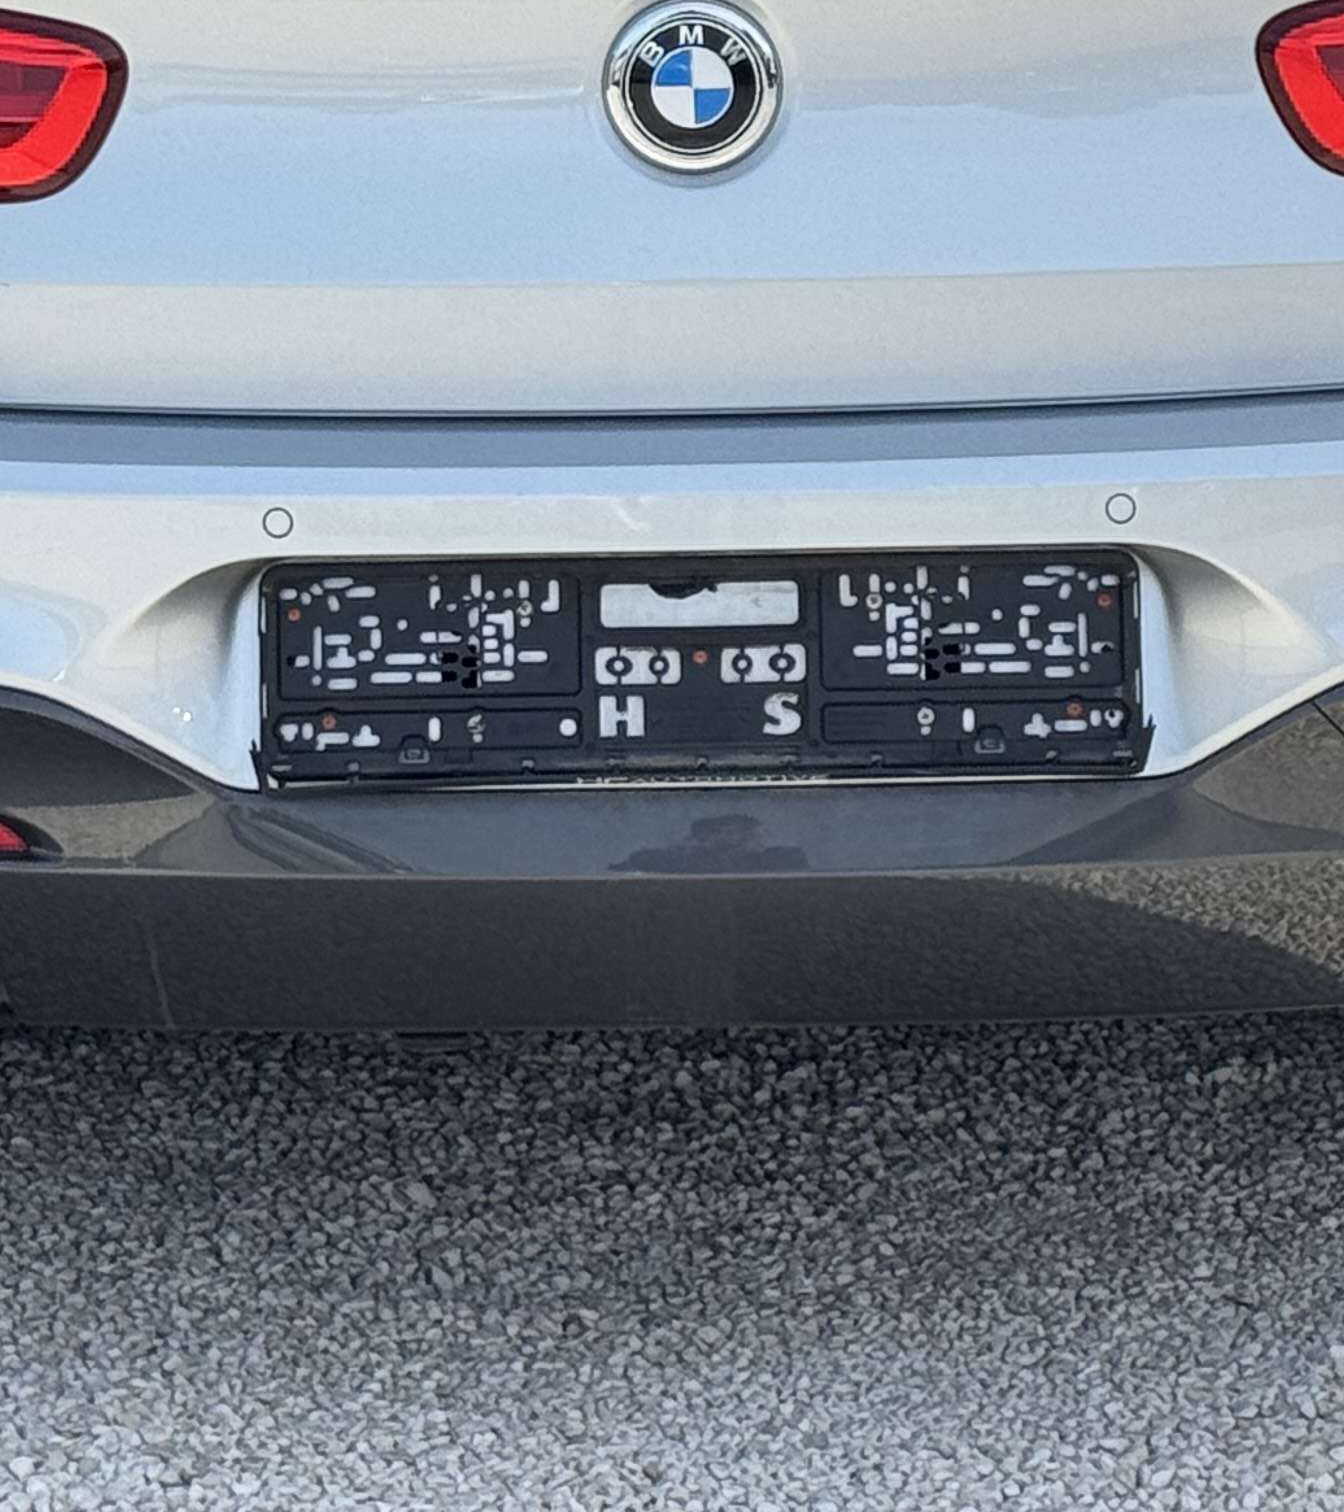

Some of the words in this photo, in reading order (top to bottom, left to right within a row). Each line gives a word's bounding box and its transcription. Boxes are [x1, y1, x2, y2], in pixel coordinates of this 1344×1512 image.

[638, 24, 748, 68] BMW
[599, 695, 645, 737] H
[762, 691, 802, 736] S
